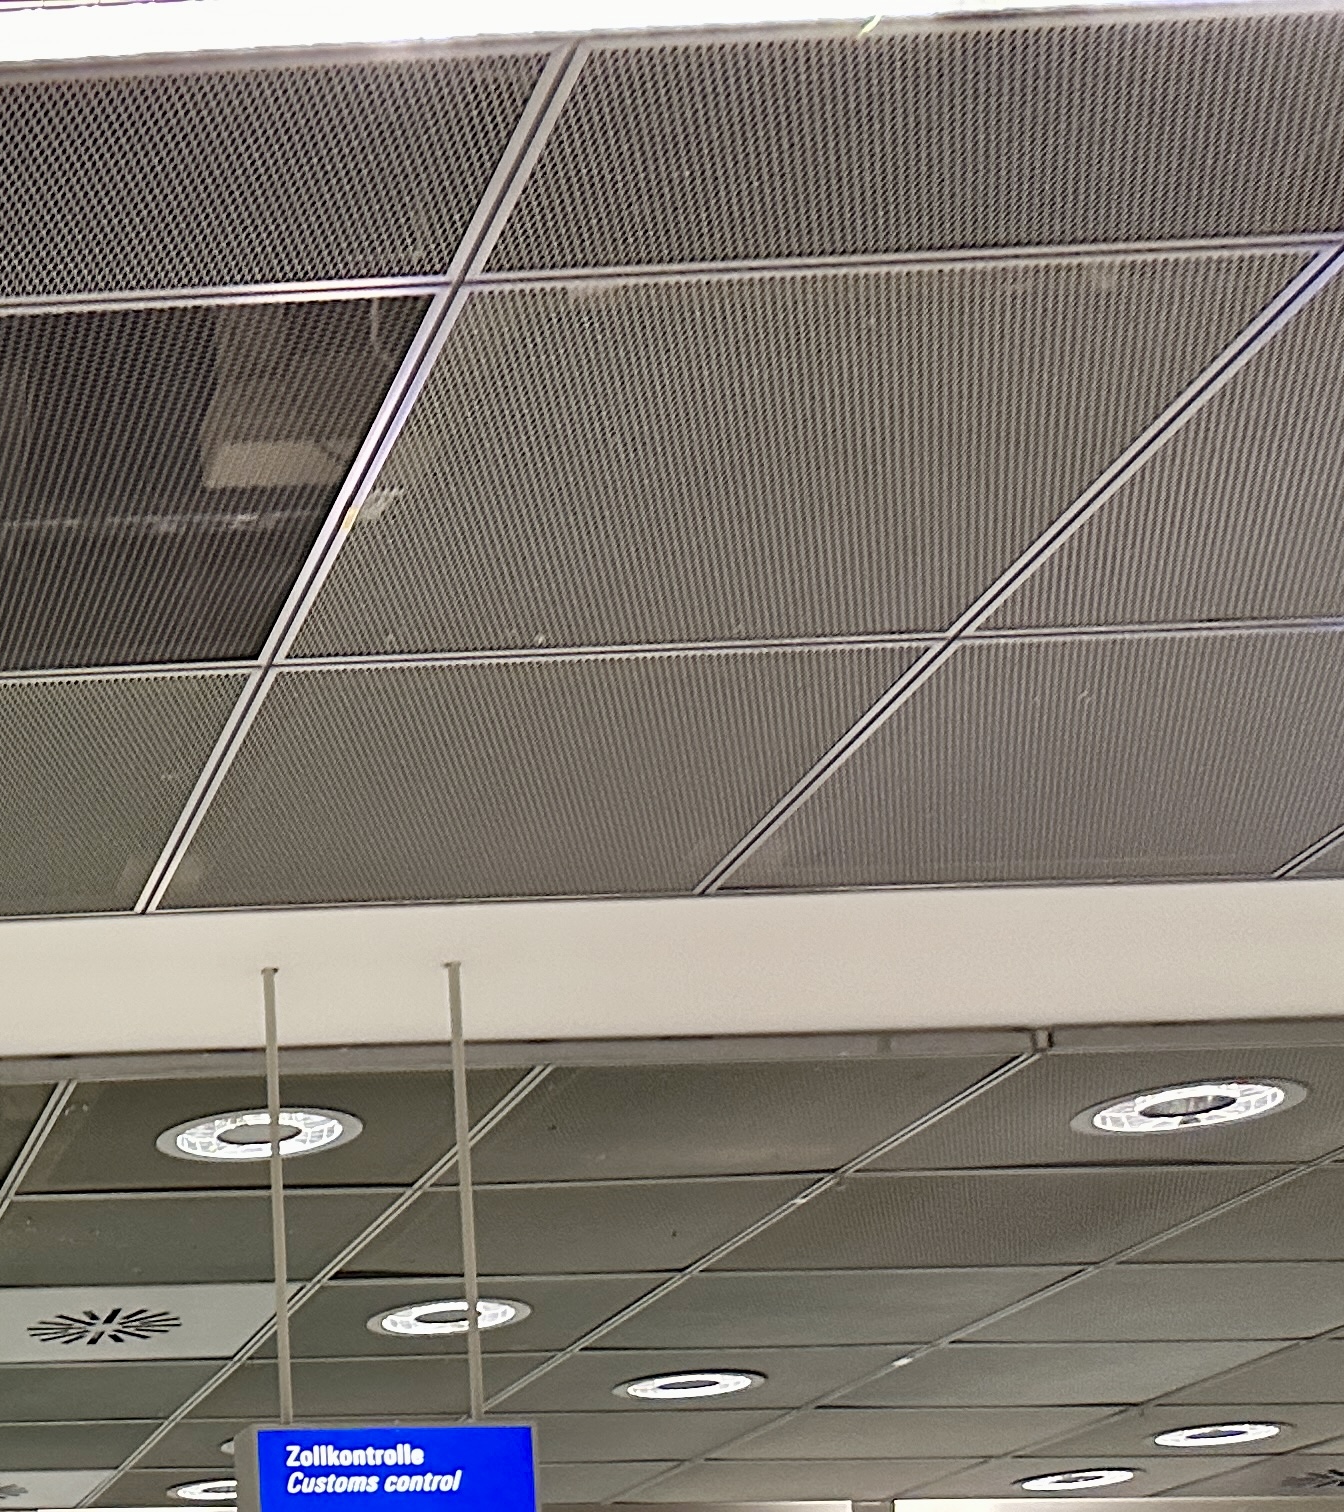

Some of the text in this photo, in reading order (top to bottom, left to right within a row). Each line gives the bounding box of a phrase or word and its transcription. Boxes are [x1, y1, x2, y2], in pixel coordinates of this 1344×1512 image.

[285, 1443, 424, 1467] Zollkontrolle
[286, 1469, 462, 1494] Customs control
